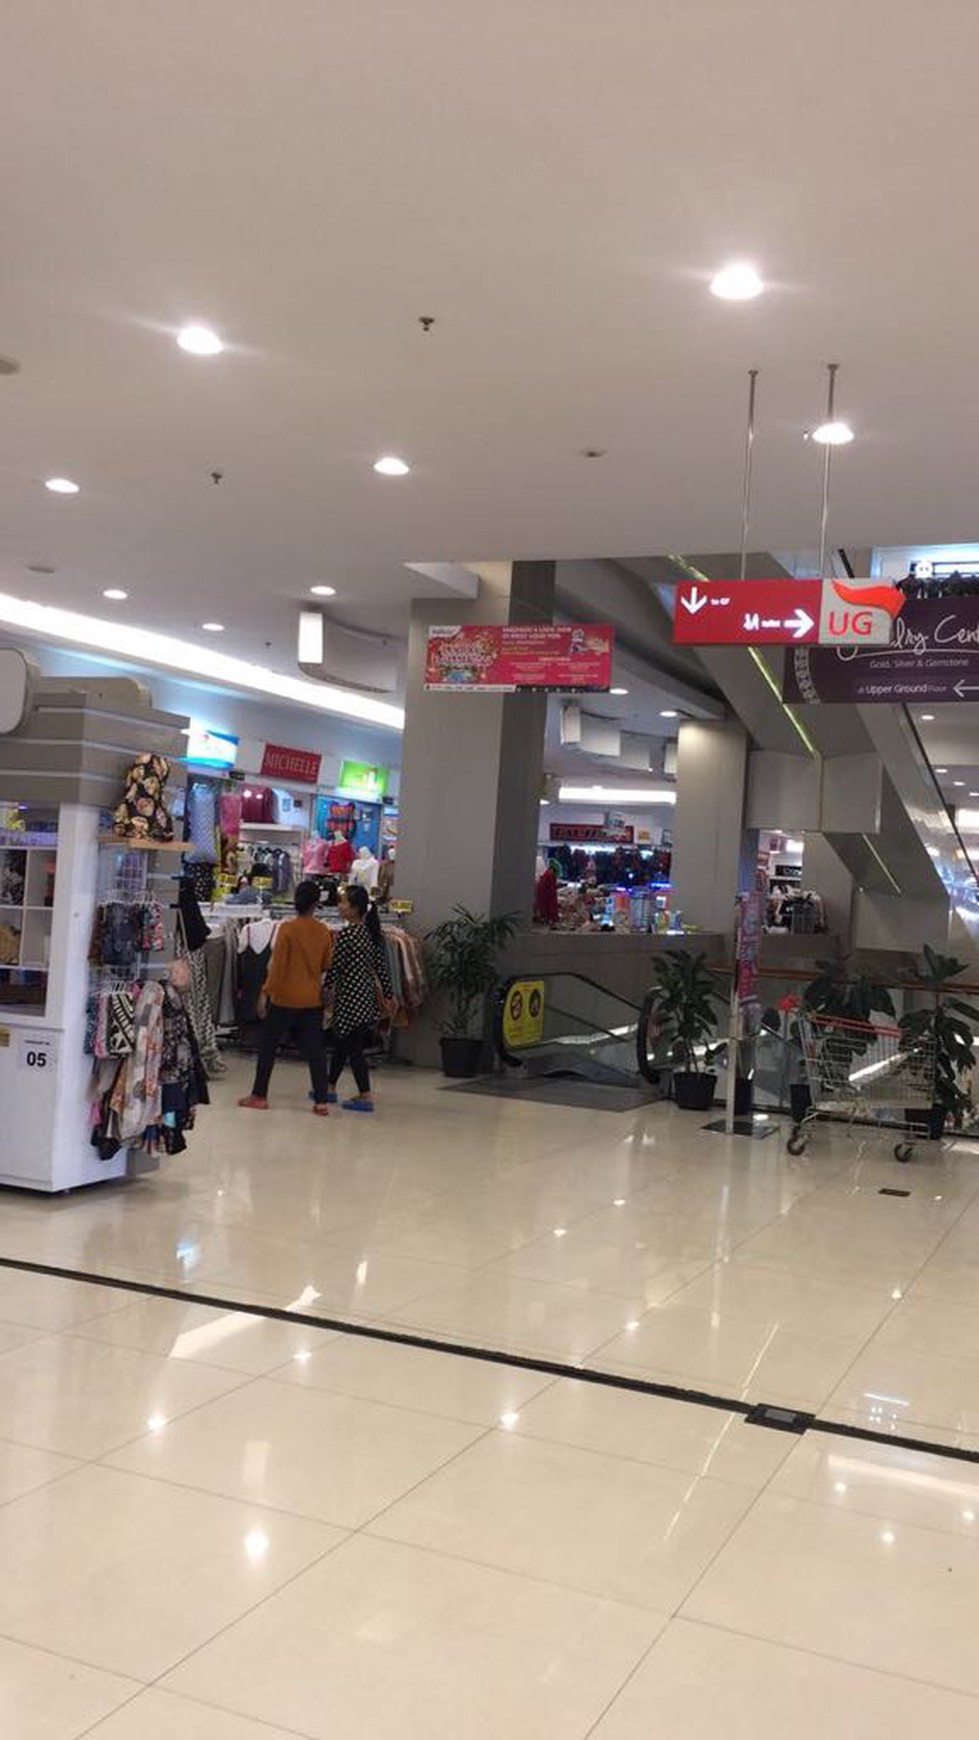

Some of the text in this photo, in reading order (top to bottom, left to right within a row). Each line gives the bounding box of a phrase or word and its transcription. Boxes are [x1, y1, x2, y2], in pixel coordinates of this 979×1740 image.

[828, 611, 873, 637] UG
[916, 660, 924, 668] &
[925, 658, 970, 668] Gemstone
[866, 684, 892, 695] Upper
[894, 683, 927, 694] Ground
[263, 751, 317, 775] MICHELLE
[26, 1051, 47, 1068] 05
